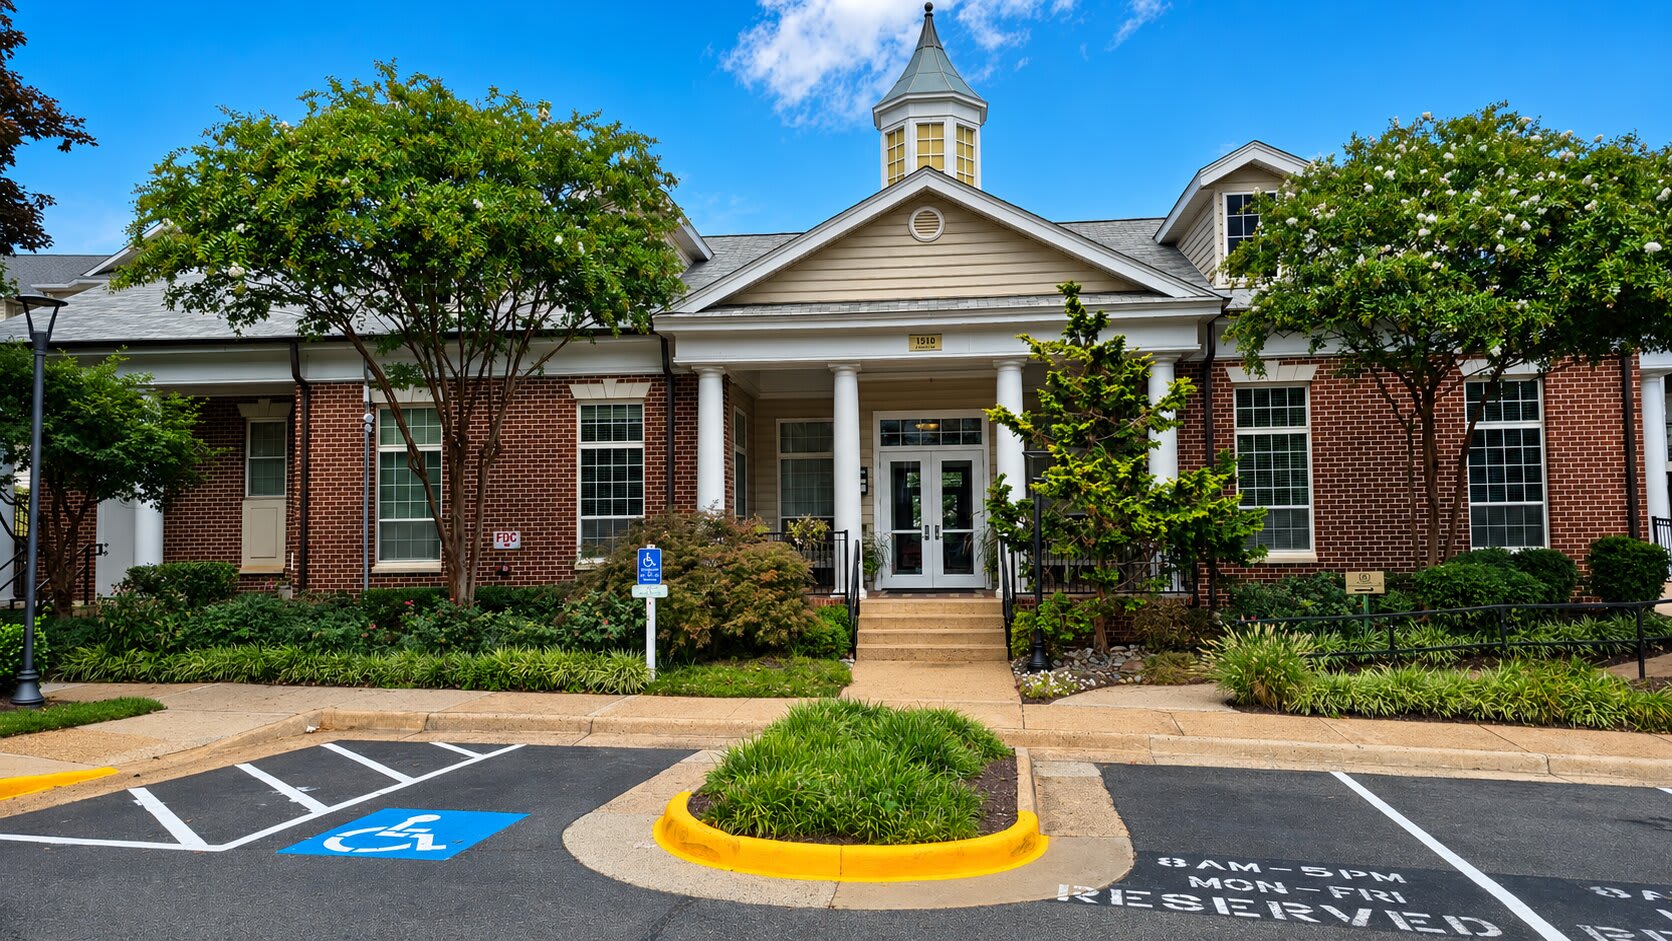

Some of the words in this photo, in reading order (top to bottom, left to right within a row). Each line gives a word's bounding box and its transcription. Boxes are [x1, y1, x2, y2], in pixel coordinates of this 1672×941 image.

[916, 337, 936, 345] 1510
[496, 532, 517, 543] FDC
[1057, 883, 1503, 937] RESERVED
